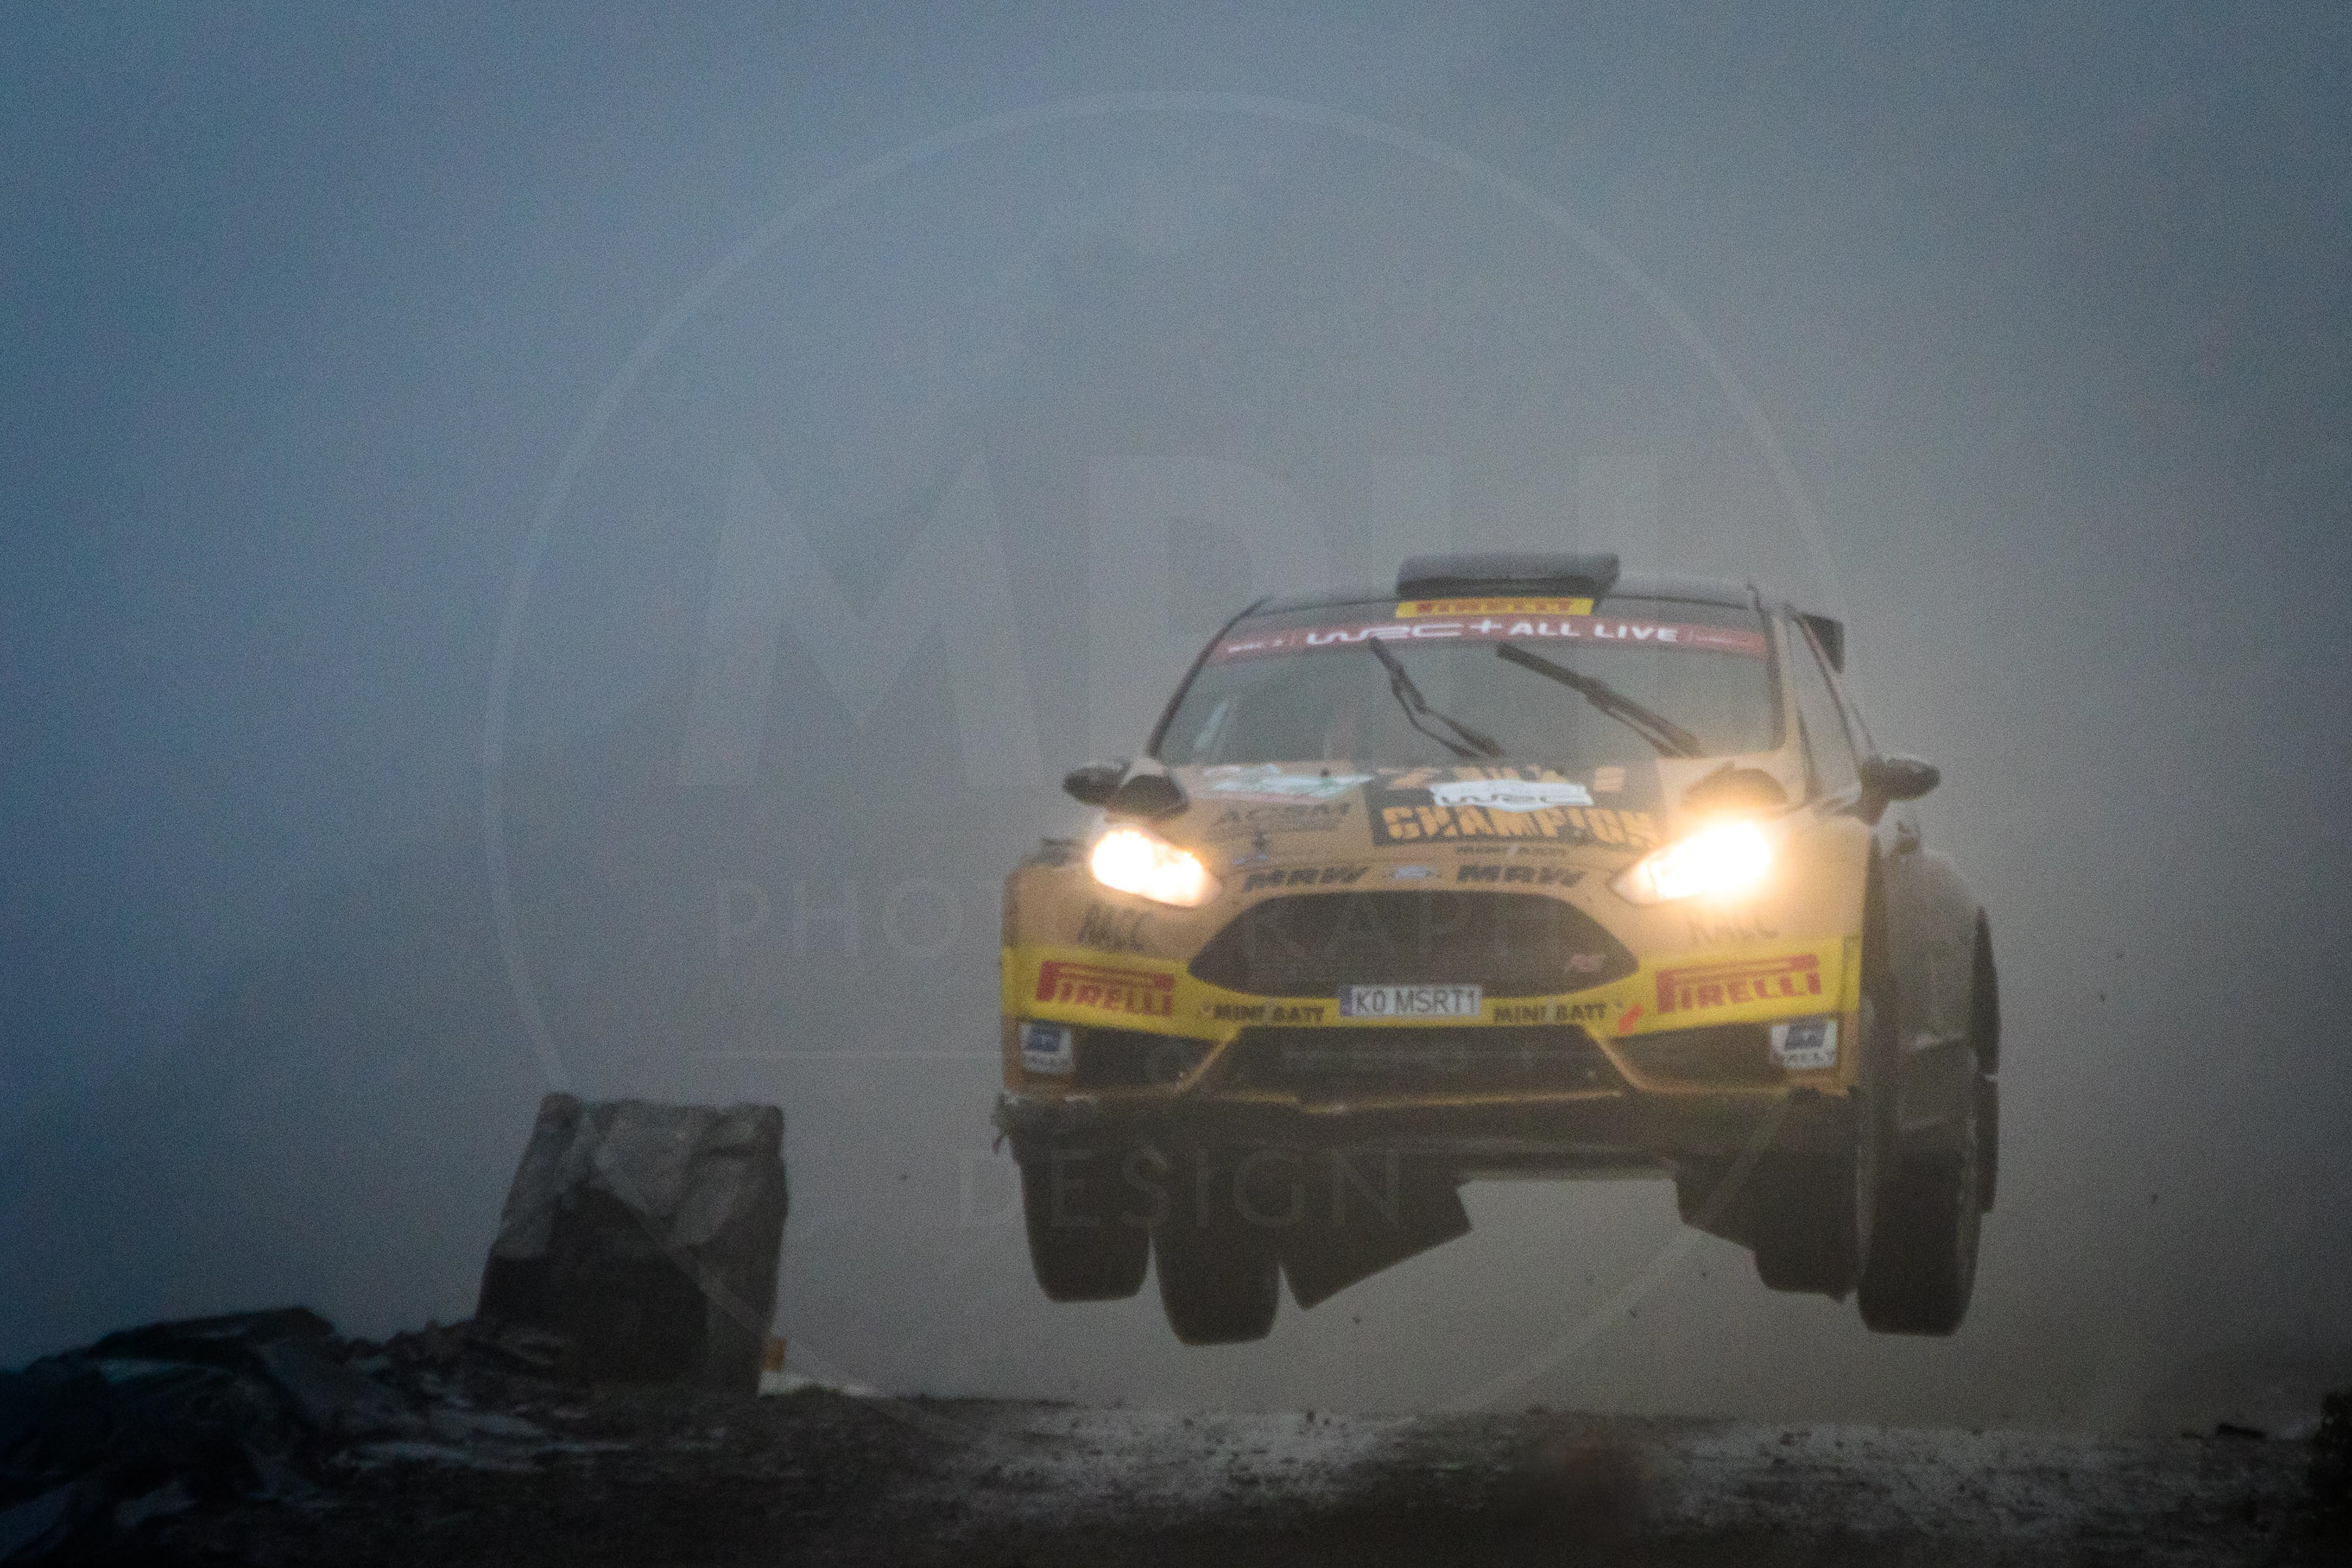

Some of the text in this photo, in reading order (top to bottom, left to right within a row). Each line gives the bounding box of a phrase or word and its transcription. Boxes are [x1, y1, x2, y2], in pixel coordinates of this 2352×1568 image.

[1509, 621, 1580, 637] ALL
[1594, 623, 1678, 643] LIVE
[1036, 961, 1175, 1017] PIRELLI
[1656, 953, 1822, 1014] PIRELLI
[1493, 1006, 1547, 1023] MINI
